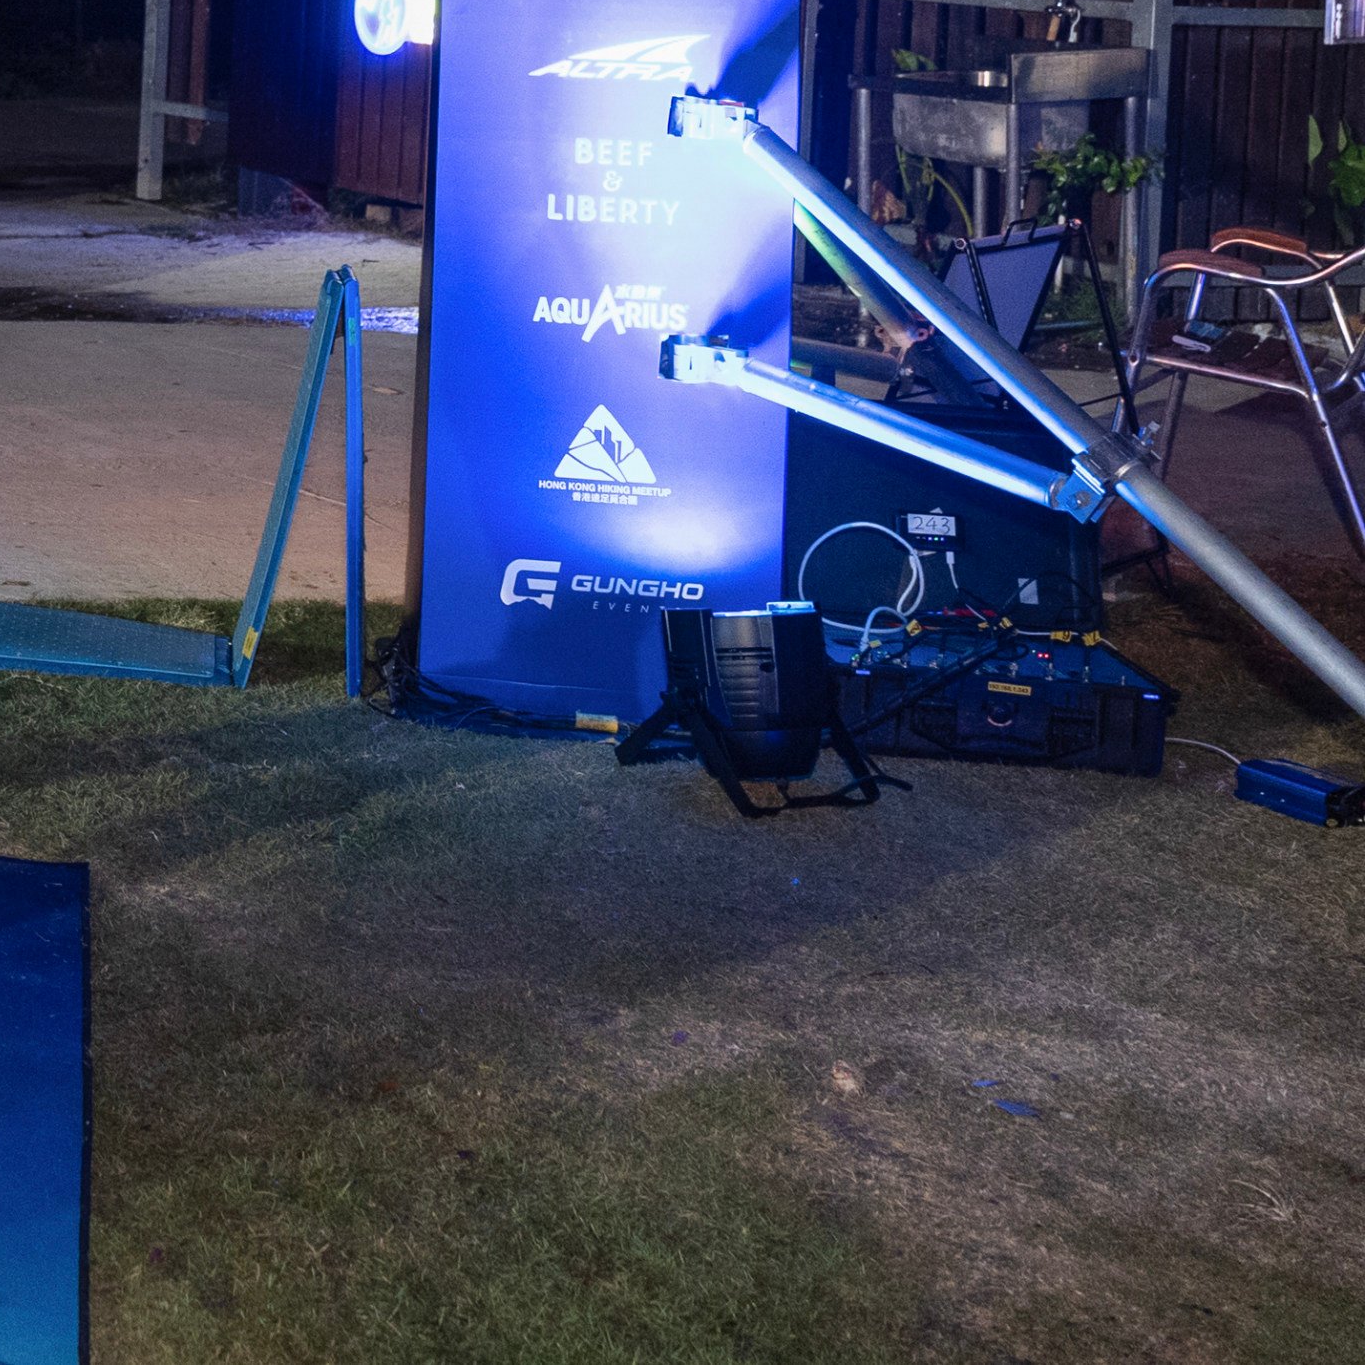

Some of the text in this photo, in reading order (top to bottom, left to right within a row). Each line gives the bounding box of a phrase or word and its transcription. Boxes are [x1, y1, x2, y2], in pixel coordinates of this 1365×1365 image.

[528, 60, 696, 82] ALTRA
[574, 137, 654, 166] BEEF
[602, 170, 623, 192] &
[547, 193, 681, 226] LIBERTY
[532, 284, 688, 343] AQUARIUS
[538, 479, 672, 498] HONG KONG HIKING MEETUP
[913, 516, 951, 535] 243
[571, 574, 704, 601] GUNGHO
[592, 600, 672, 613] EVEN
